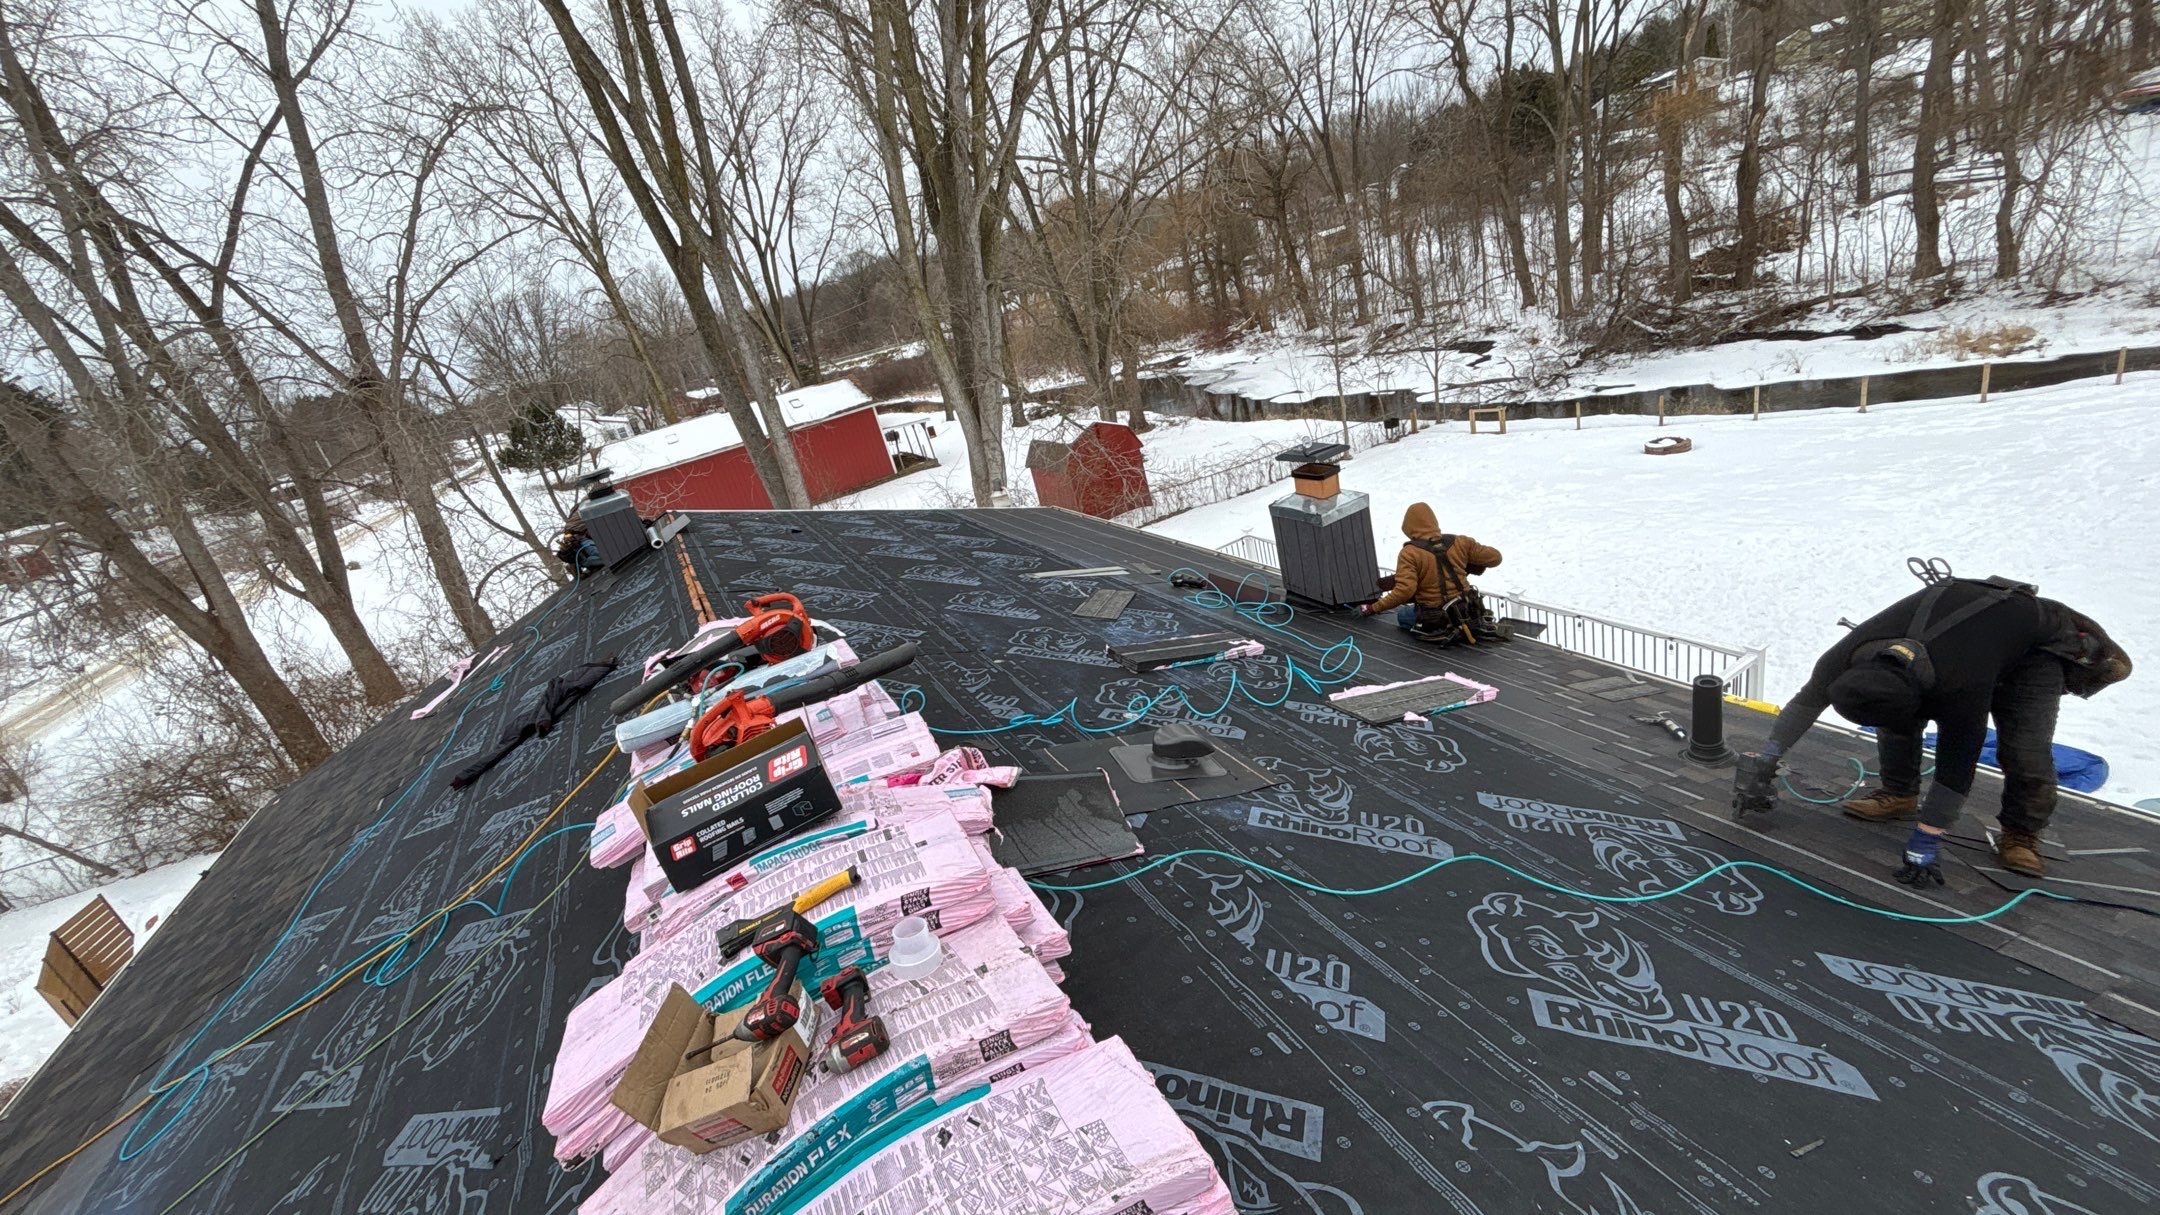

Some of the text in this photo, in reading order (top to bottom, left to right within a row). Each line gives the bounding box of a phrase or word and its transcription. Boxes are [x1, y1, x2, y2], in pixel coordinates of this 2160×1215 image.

[712, 781, 764, 812] COLLATED
[713, 773, 761, 801] ROOFING
[681, 798, 713, 818] NAILS
[696, 819, 726, 837] COLLATED
[699, 824, 727, 844] ROOFING
[1258, 810, 1438, 857] RhinoRoof
[1360, 811, 1425, 836] U20
[1507, 812, 1576, 837] U20
[1265, 948, 1351, 993] U20
[1680, 993, 1798, 1043] U20
[1885, 992, 2016, 1042] U20
[1553, 998, 1838, 1085] RhinoRoof
